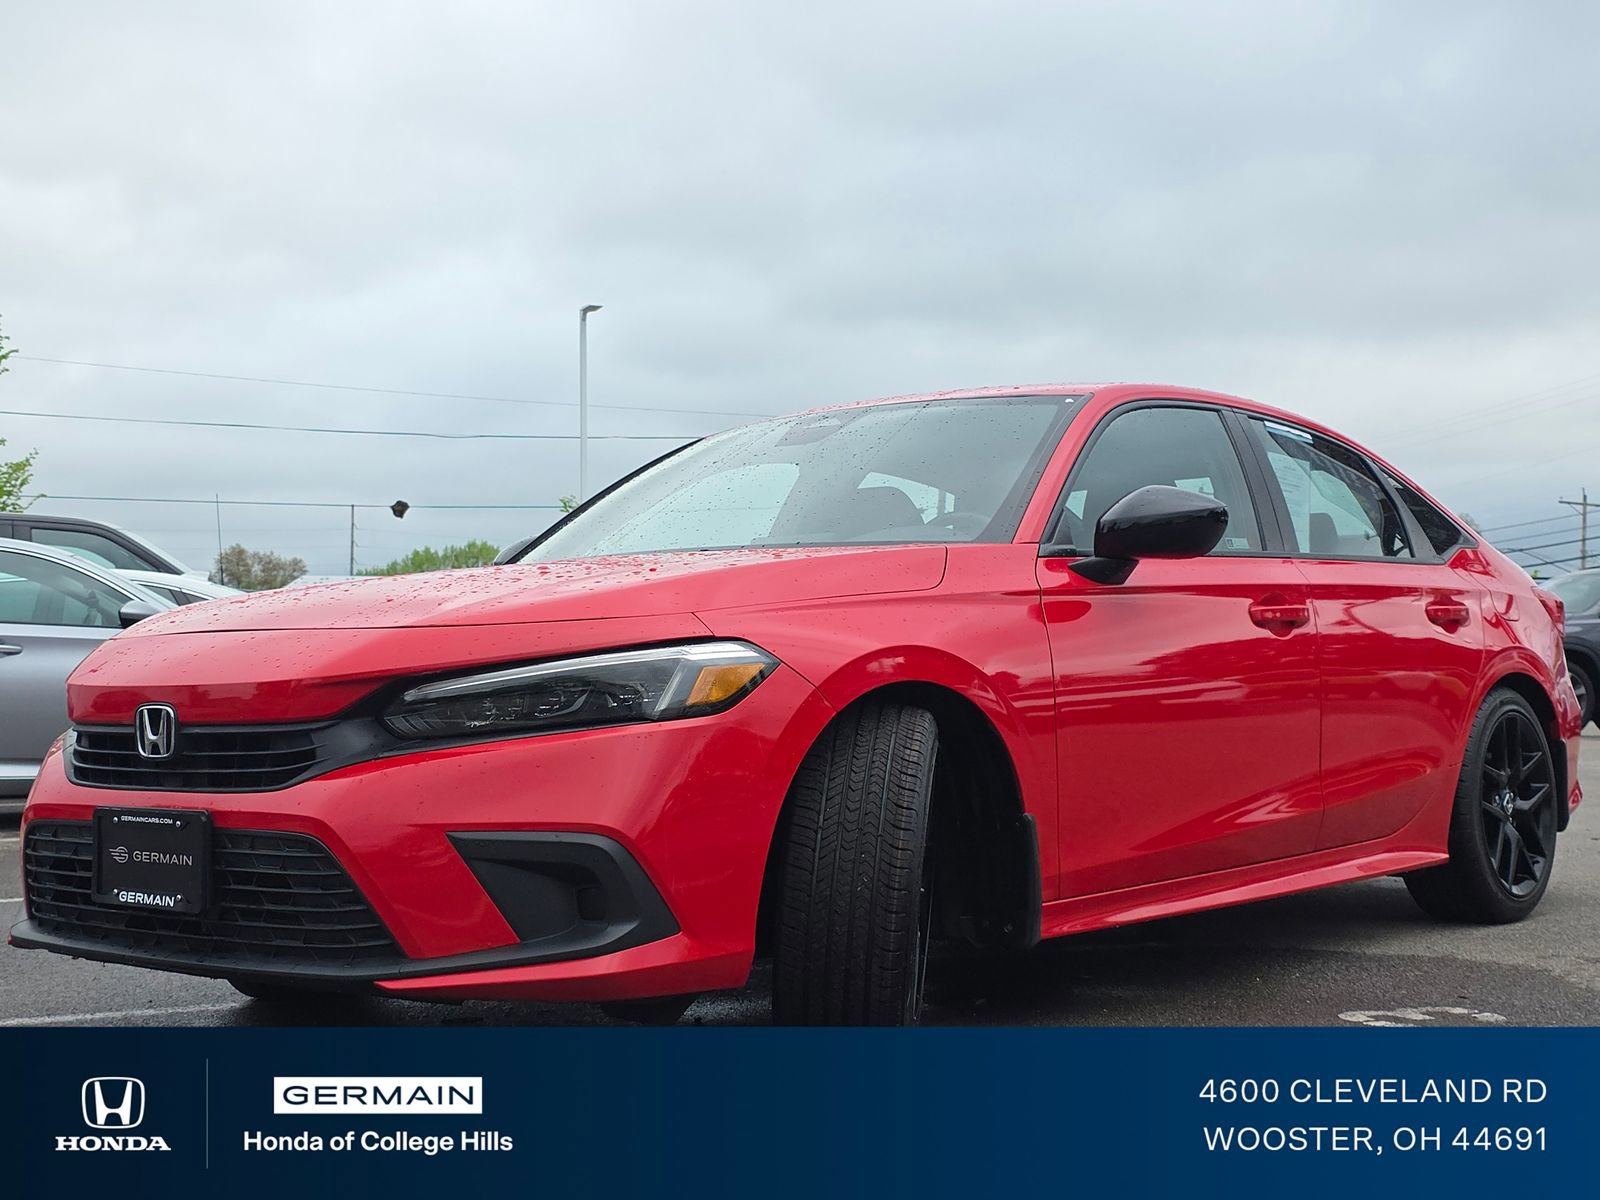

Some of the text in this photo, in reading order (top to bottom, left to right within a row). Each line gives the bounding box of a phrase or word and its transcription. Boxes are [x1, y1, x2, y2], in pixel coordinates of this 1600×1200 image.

[120, 815, 174, 825] GERMAINCARS.COM
[132, 851, 193, 866] GERMAIN
[118, 891, 175, 908] GERMAIN
